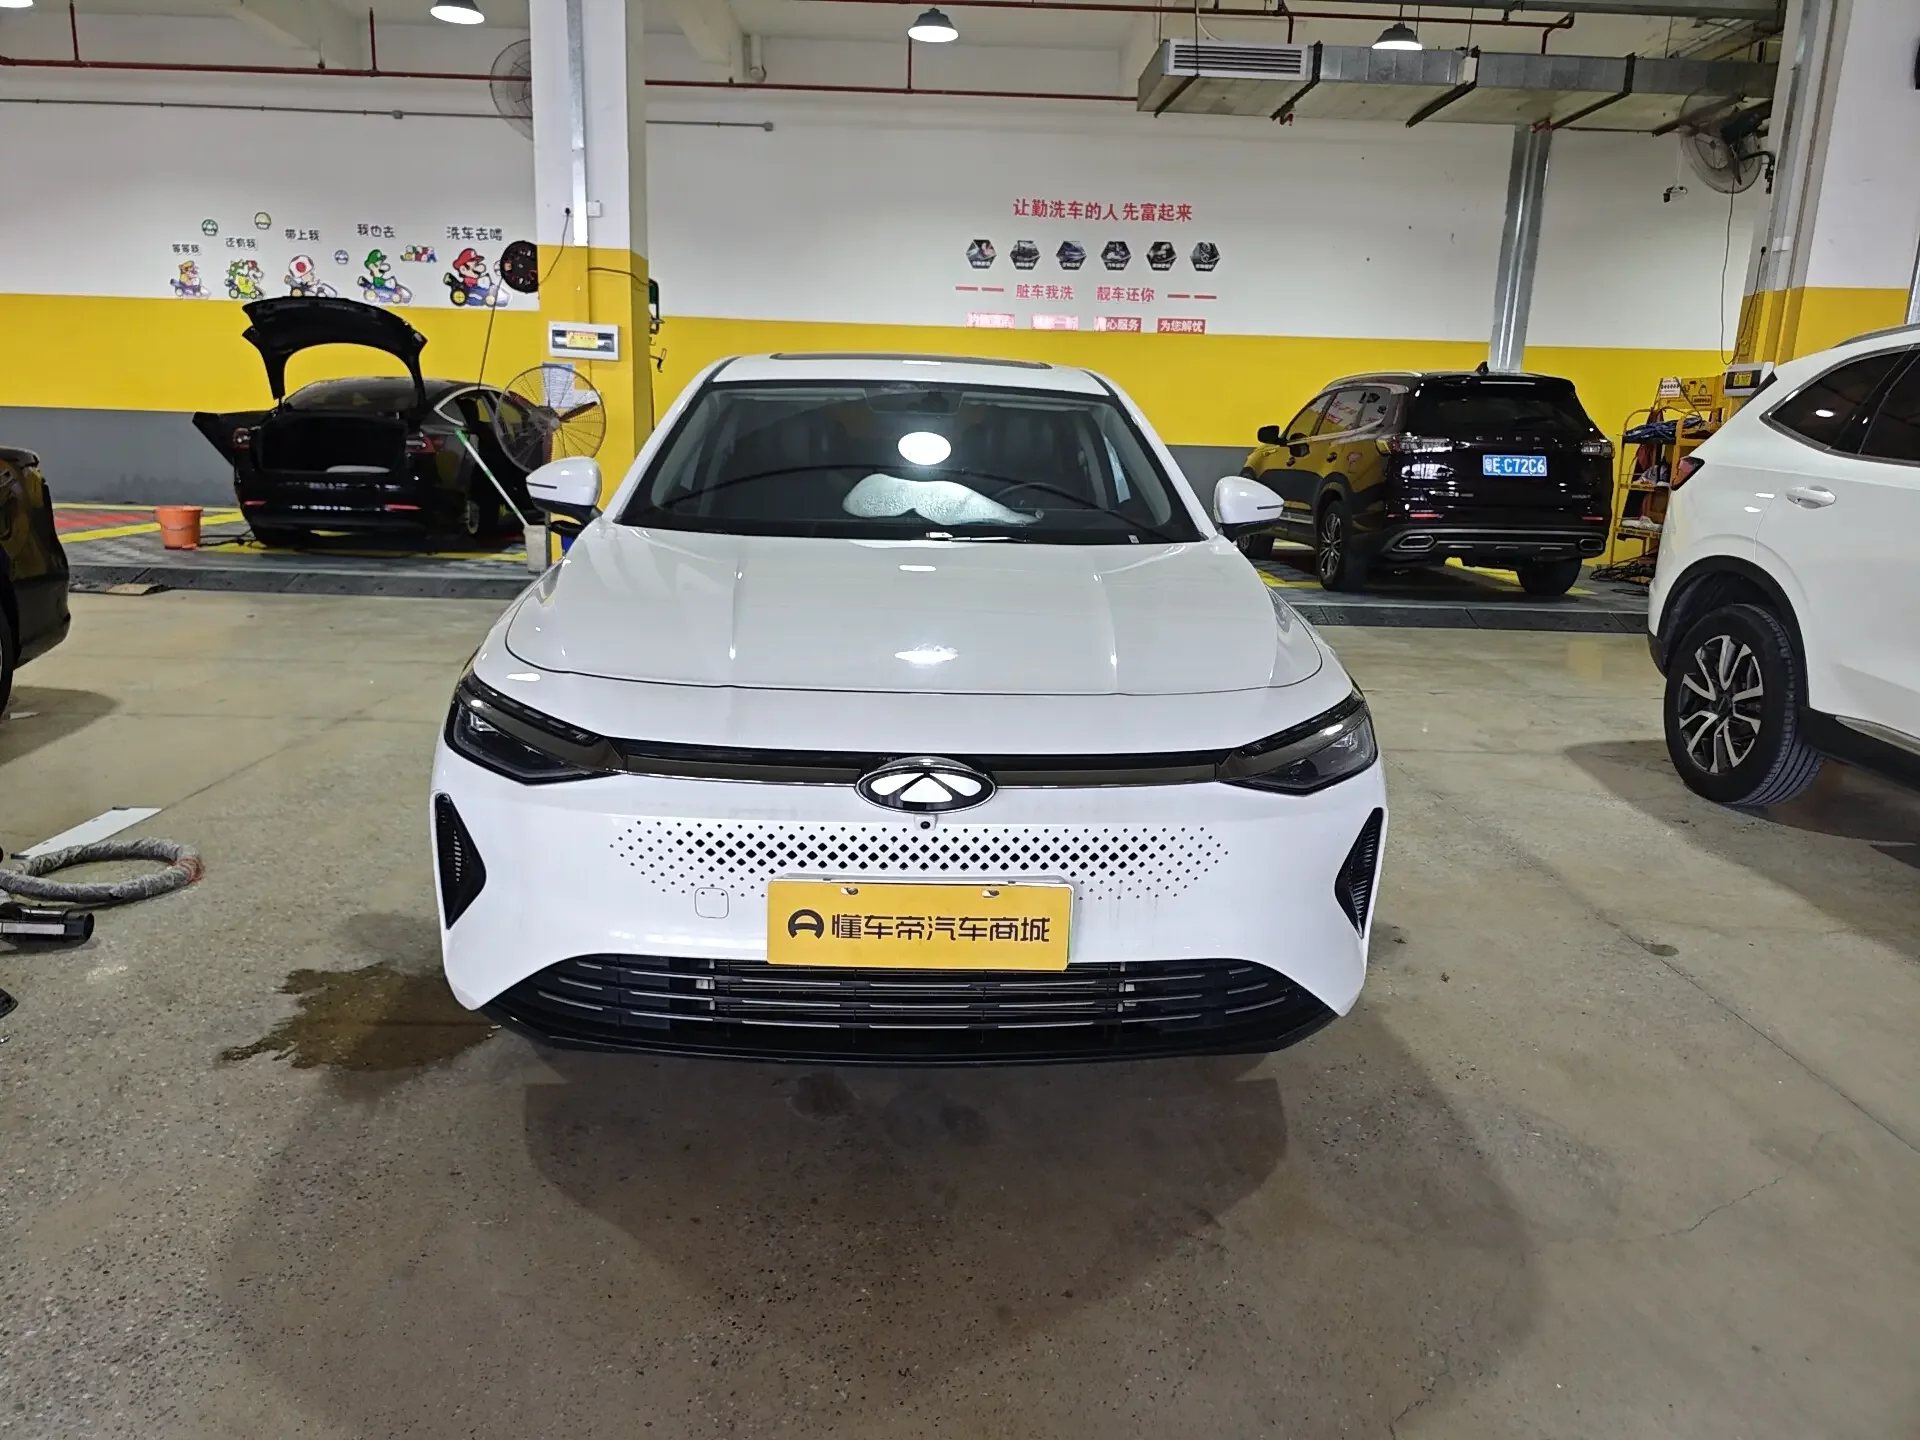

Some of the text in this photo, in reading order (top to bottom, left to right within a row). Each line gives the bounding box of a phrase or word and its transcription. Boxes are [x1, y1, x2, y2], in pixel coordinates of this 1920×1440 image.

[1012, 198, 1193, 223] 让勤洗车的人先富起来
[284, 228, 320, 241] 带上我
[356, 223, 396, 239] 我也去
[225, 237, 256, 249] 还有我
[1016, 284, 1156, 303] 脏车我洗 靓车还你
[1159, 319, 1204, 333] 为您解忧
[831, 914, 1051, 943] 懂车帝汽车商城
